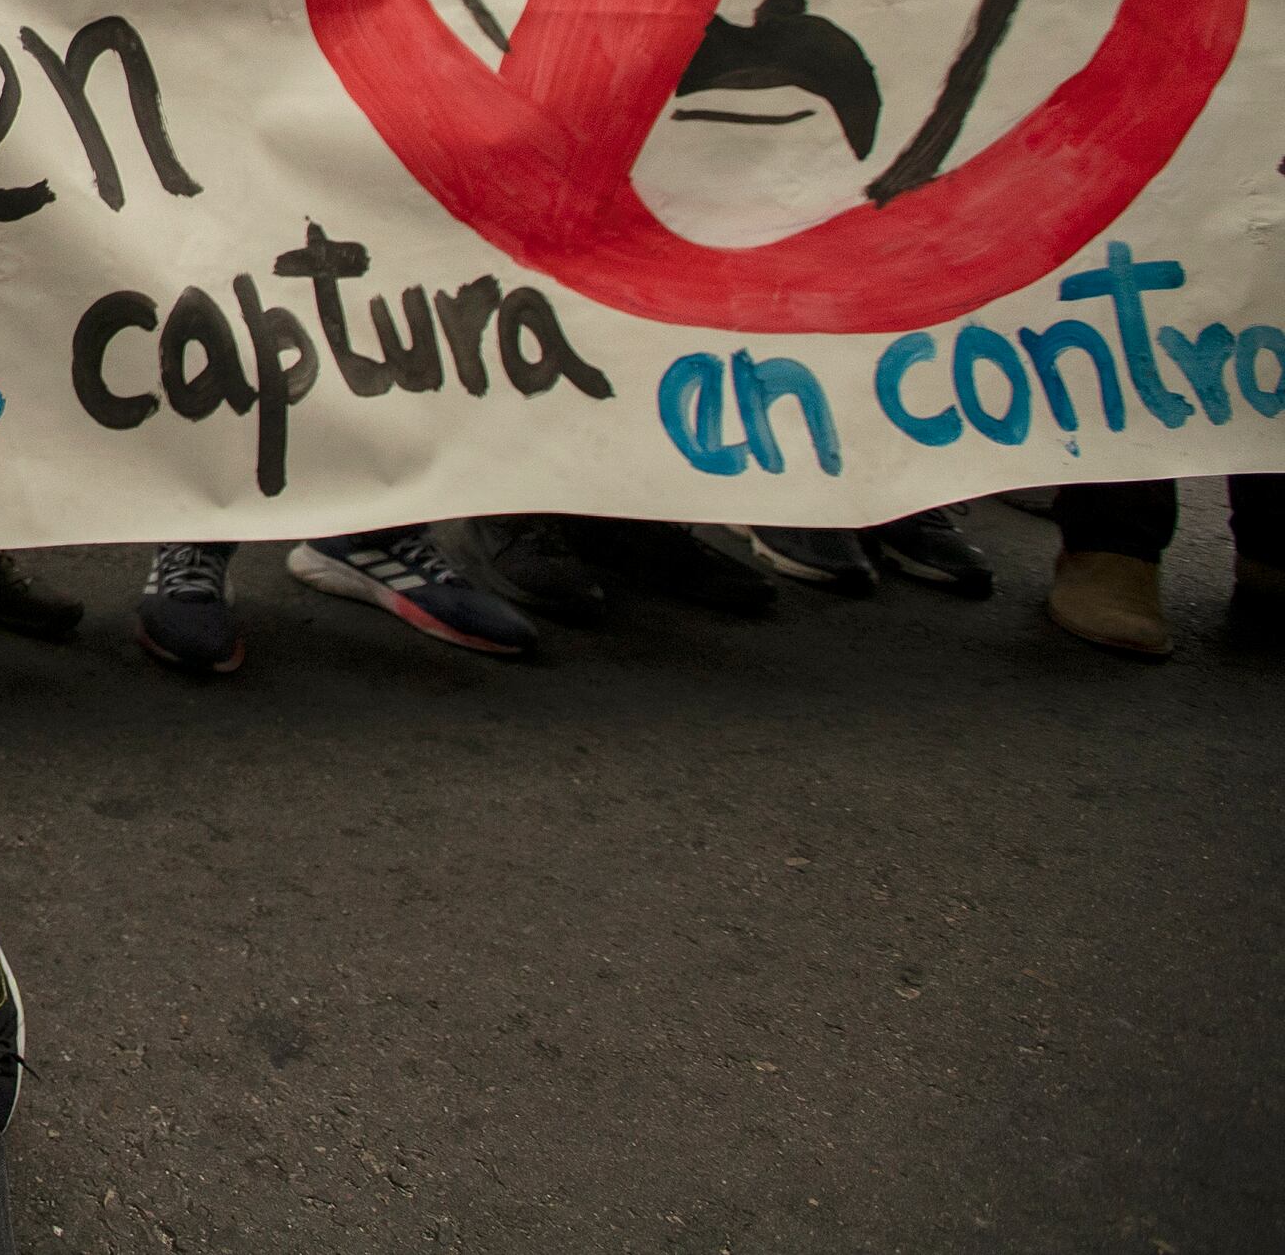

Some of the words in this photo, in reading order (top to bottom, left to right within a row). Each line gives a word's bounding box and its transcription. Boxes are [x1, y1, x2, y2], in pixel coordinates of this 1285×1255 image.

[71, 215, 617, 498] captura
[657, 348, 844, 478] en
[874, 240, 1285, 447] contra
